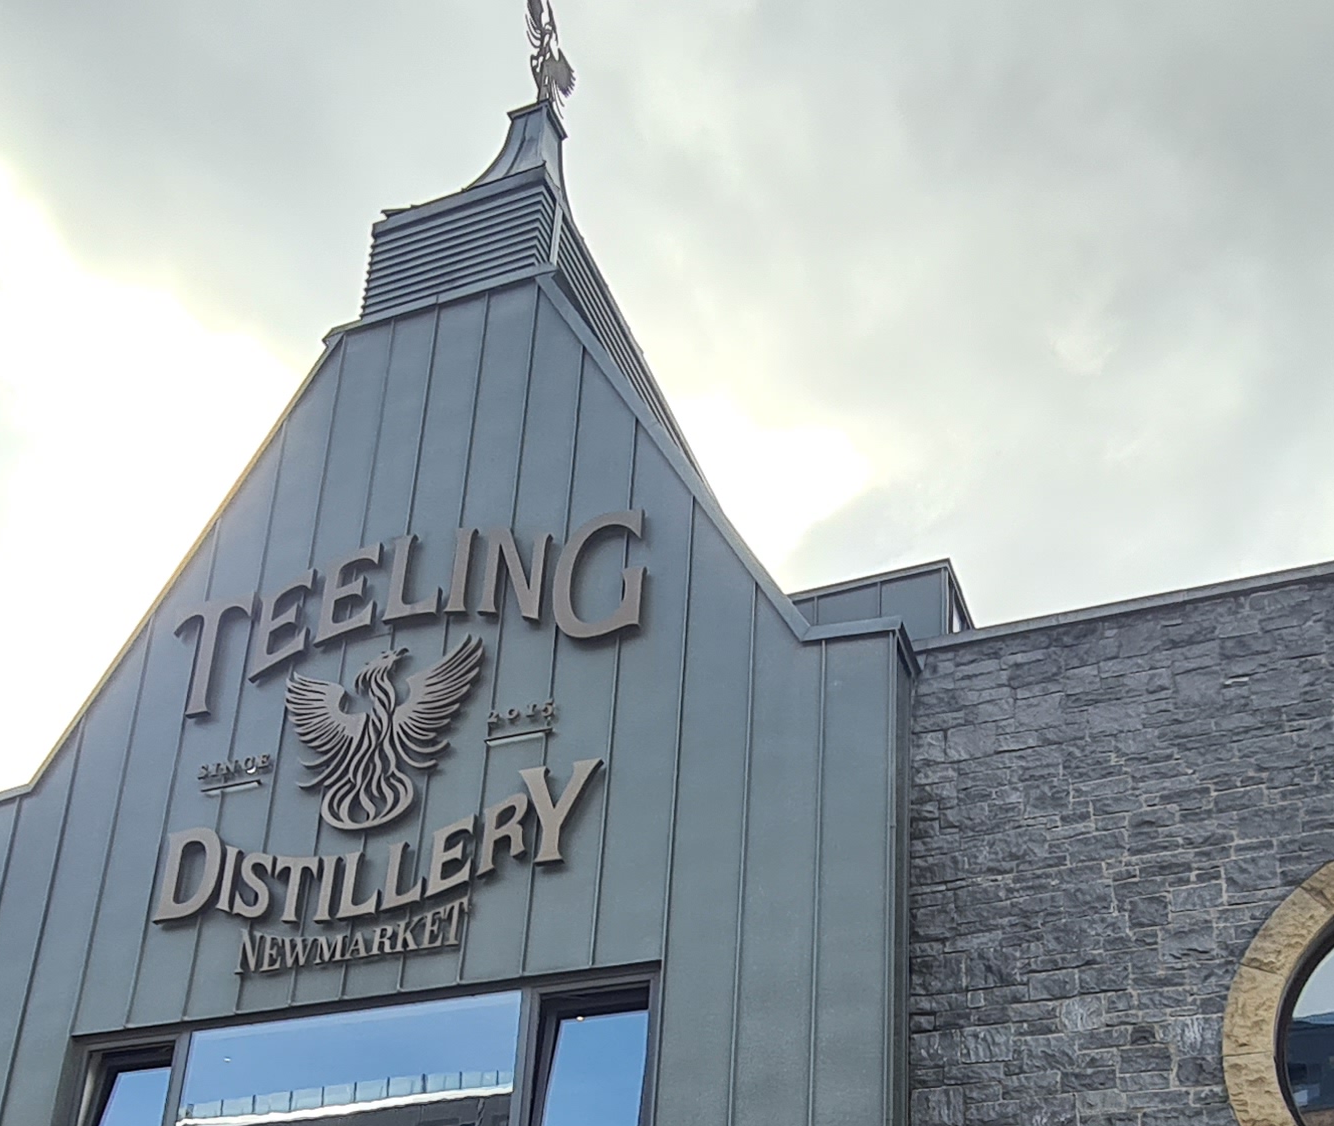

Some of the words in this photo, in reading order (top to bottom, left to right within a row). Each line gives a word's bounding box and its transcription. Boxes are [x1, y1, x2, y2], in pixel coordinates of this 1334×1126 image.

[173, 508, 648, 718] TEELING
[197, 753, 271, 780] SINCE
[486, 697, 556, 723] 2015
[152, 758, 605, 926] DISTILLERY
[234, 899, 470, 975] NEWMARKET
